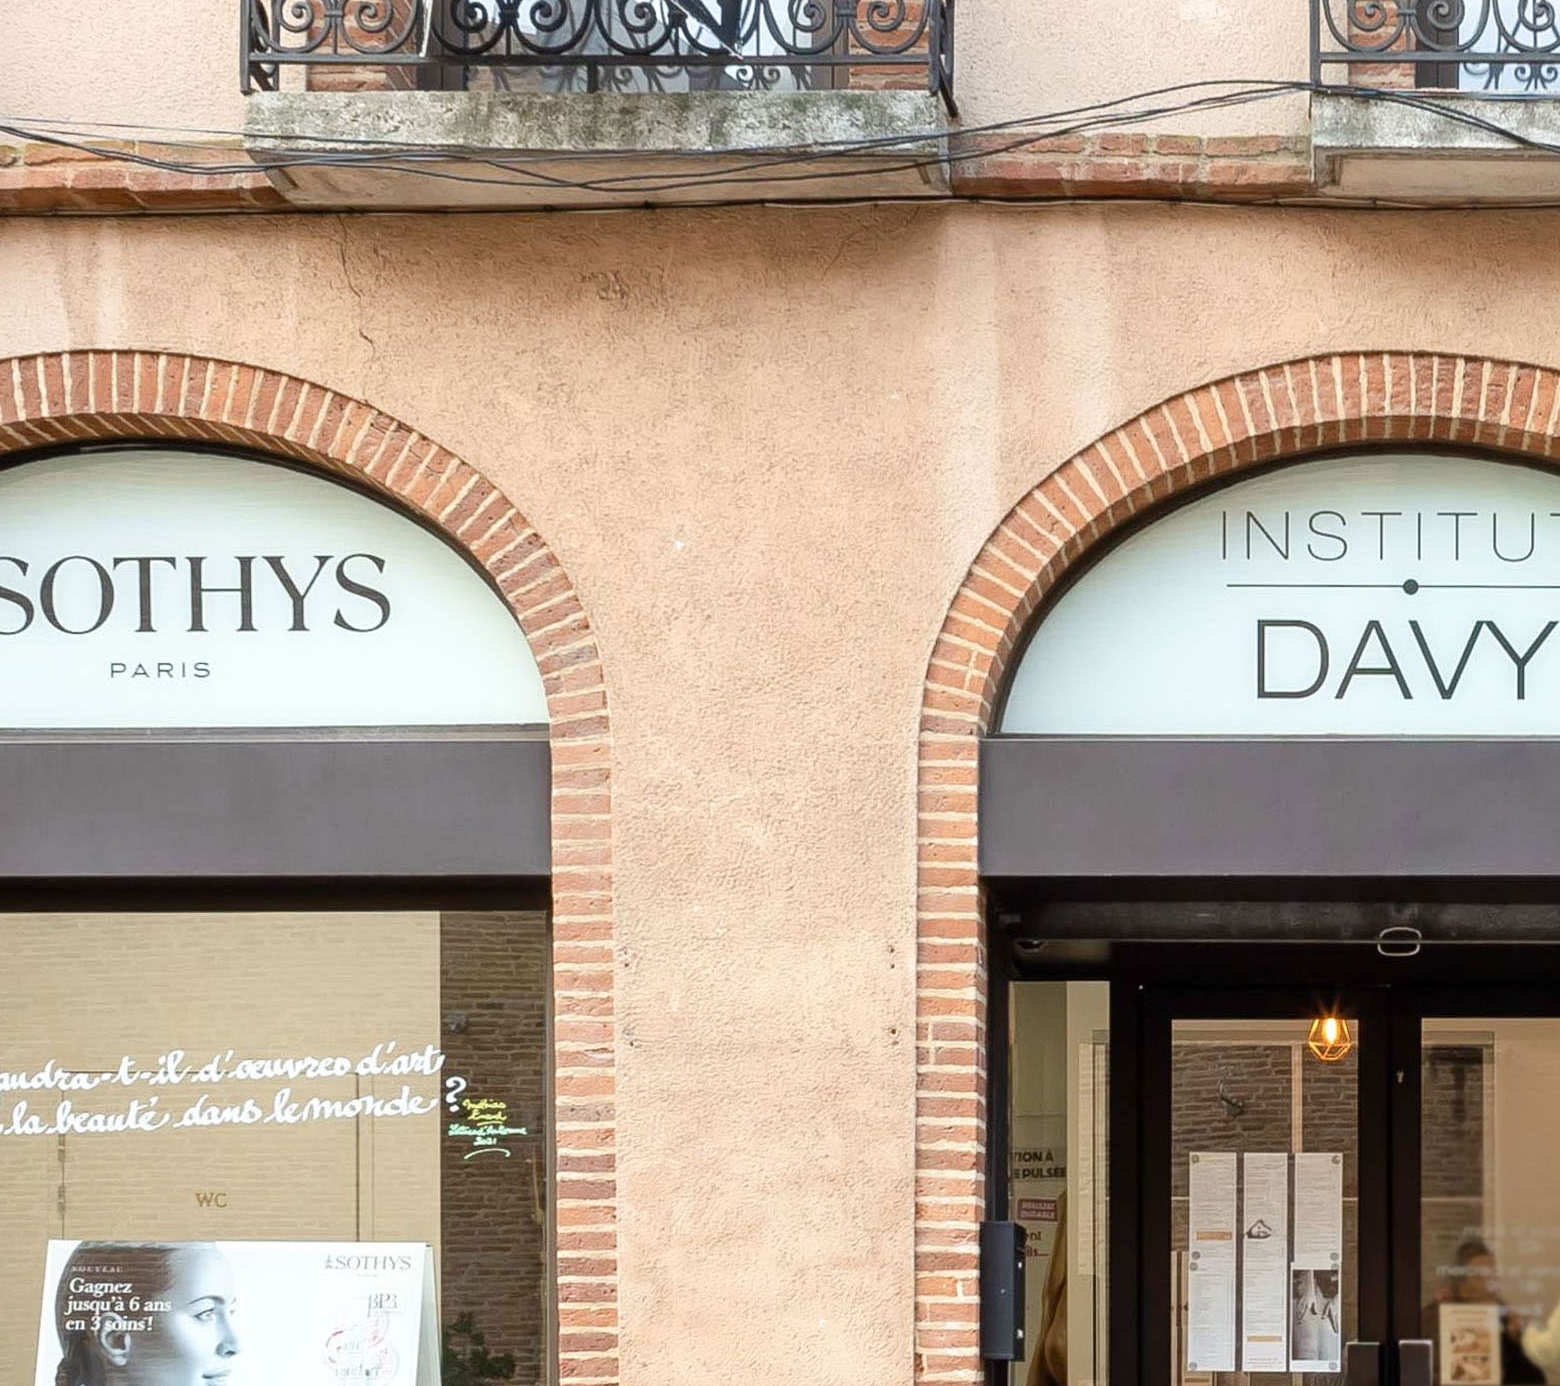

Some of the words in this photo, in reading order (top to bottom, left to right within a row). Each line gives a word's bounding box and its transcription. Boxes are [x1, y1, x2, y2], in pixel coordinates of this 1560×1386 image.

[111, 662, 211, 678] PARIS
[1256, 619, 1559, 701] DAVY
[349, 1041, 445, 1076] d'art
[4, 1099, 49, 1135] la
[43, 1095, 172, 1135] beauté
[172, 1094, 263, 1128] dans
[262, 1088, 303, 1124] le
[301, 1084, 440, 1122] monde
[195, 1192, 227, 1208] WC
[335, 1255, 412, 1270] SOTHYS
[69, 1277, 133, 1297] Gagnez
[64, 1295, 126, 1316] jusqu'à
[129, 1296, 140, 1312] 6
[143, 1300, 172, 1312] ans
[65, 1320, 86, 1331] en
[90, 1316, 101, 1331] 3
